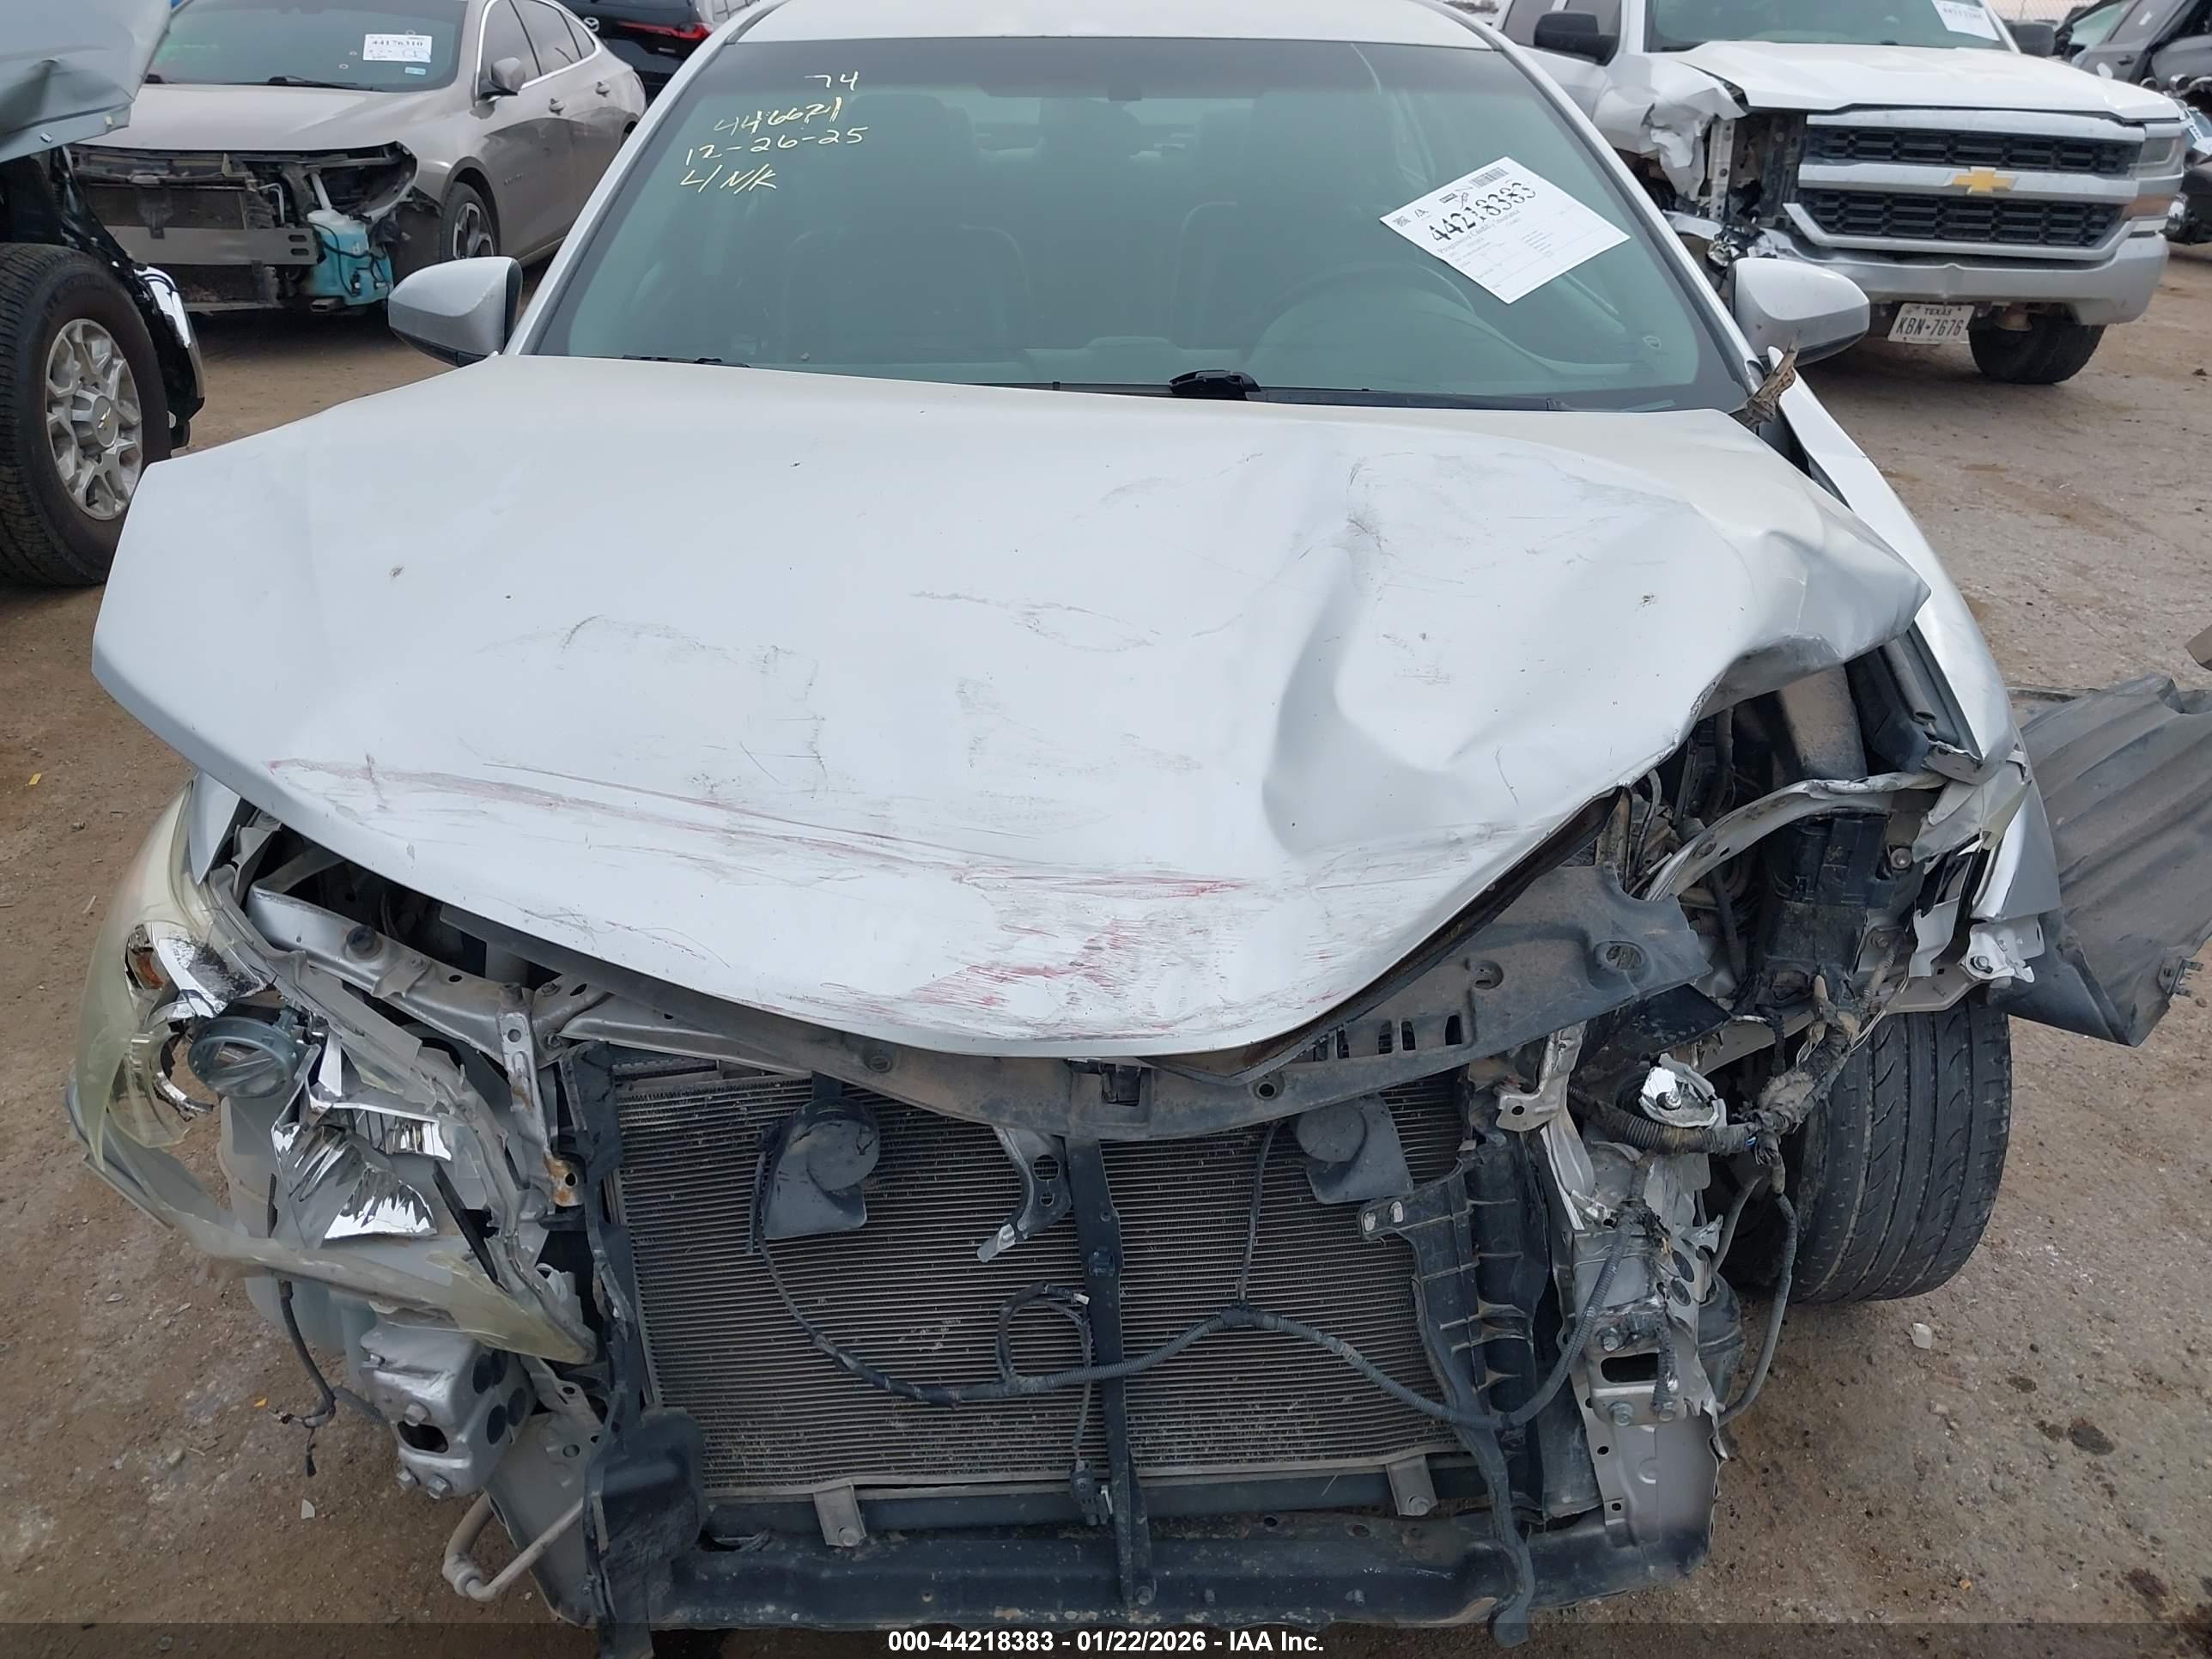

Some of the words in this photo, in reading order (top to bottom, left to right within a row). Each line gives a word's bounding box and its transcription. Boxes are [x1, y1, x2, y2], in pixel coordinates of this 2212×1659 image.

[804, 70, 860, 91] 74
[685, 126, 869, 166] 12-26-25
[1428, 181, 1537, 241] 44218383
